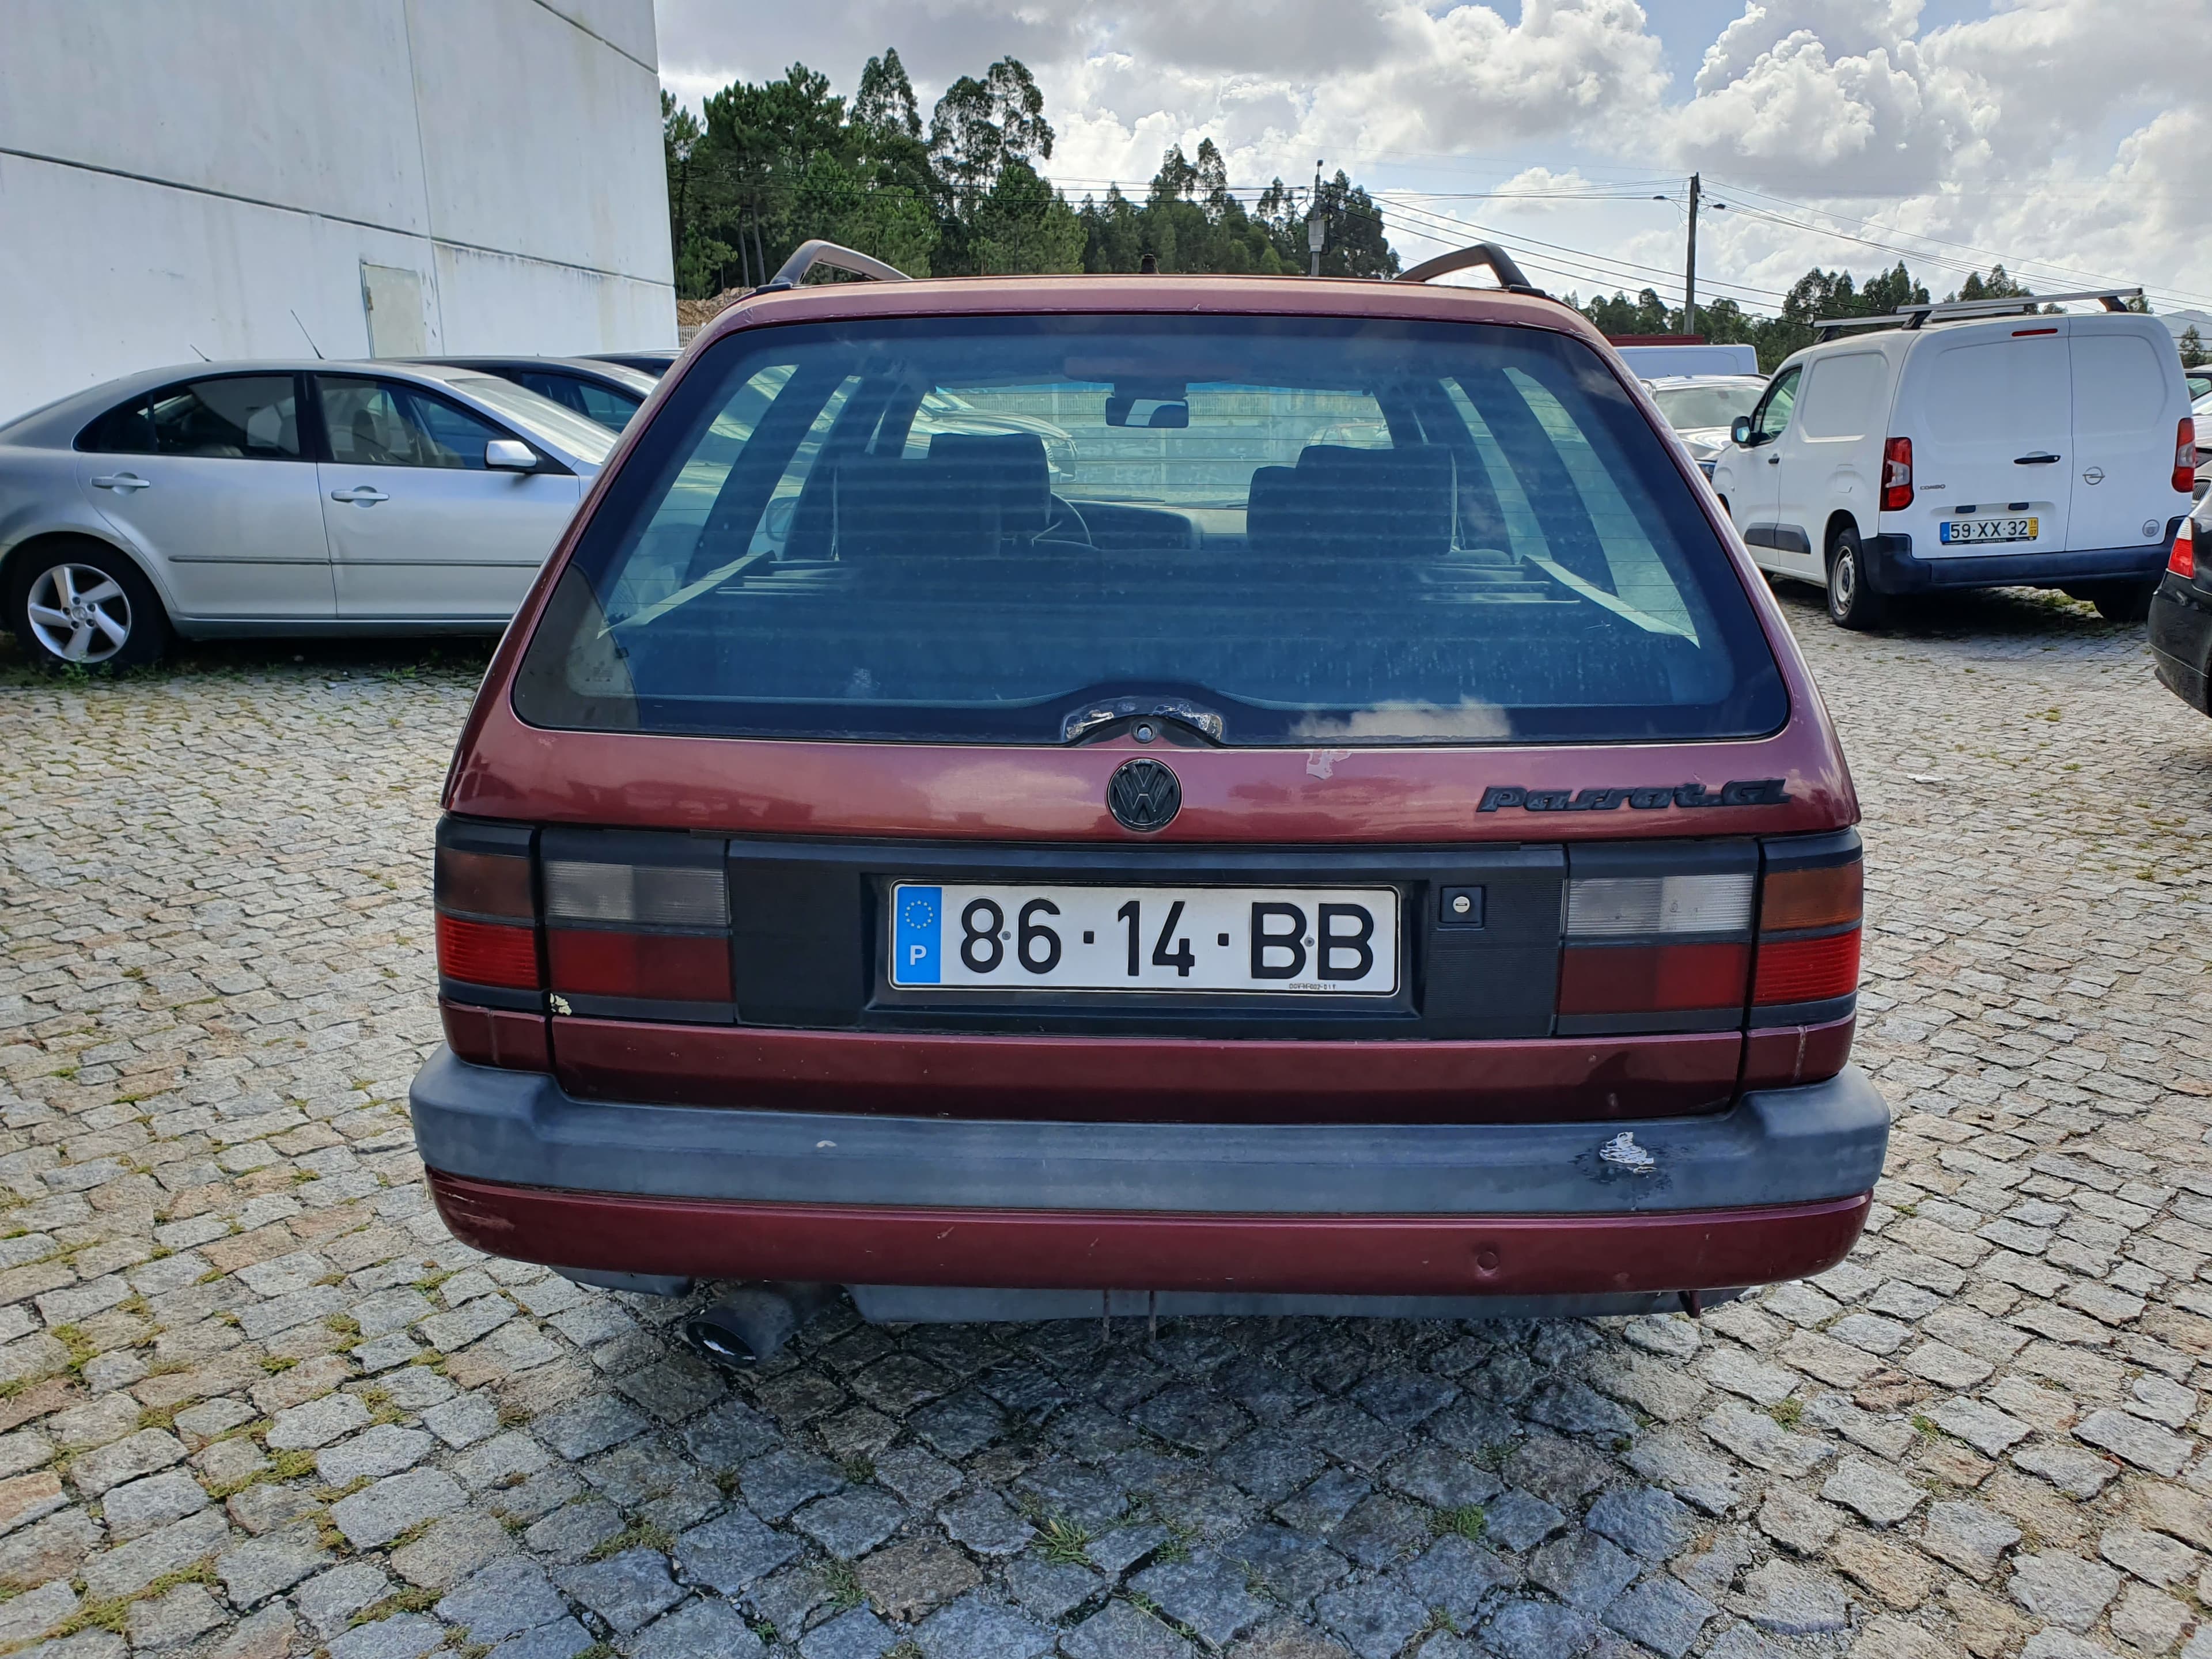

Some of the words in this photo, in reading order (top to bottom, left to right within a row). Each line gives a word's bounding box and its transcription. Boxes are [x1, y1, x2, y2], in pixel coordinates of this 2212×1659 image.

[1476, 783, 1713, 812] Passat
[1720, 778, 1791, 806] GL
[910, 945, 927, 965] P
